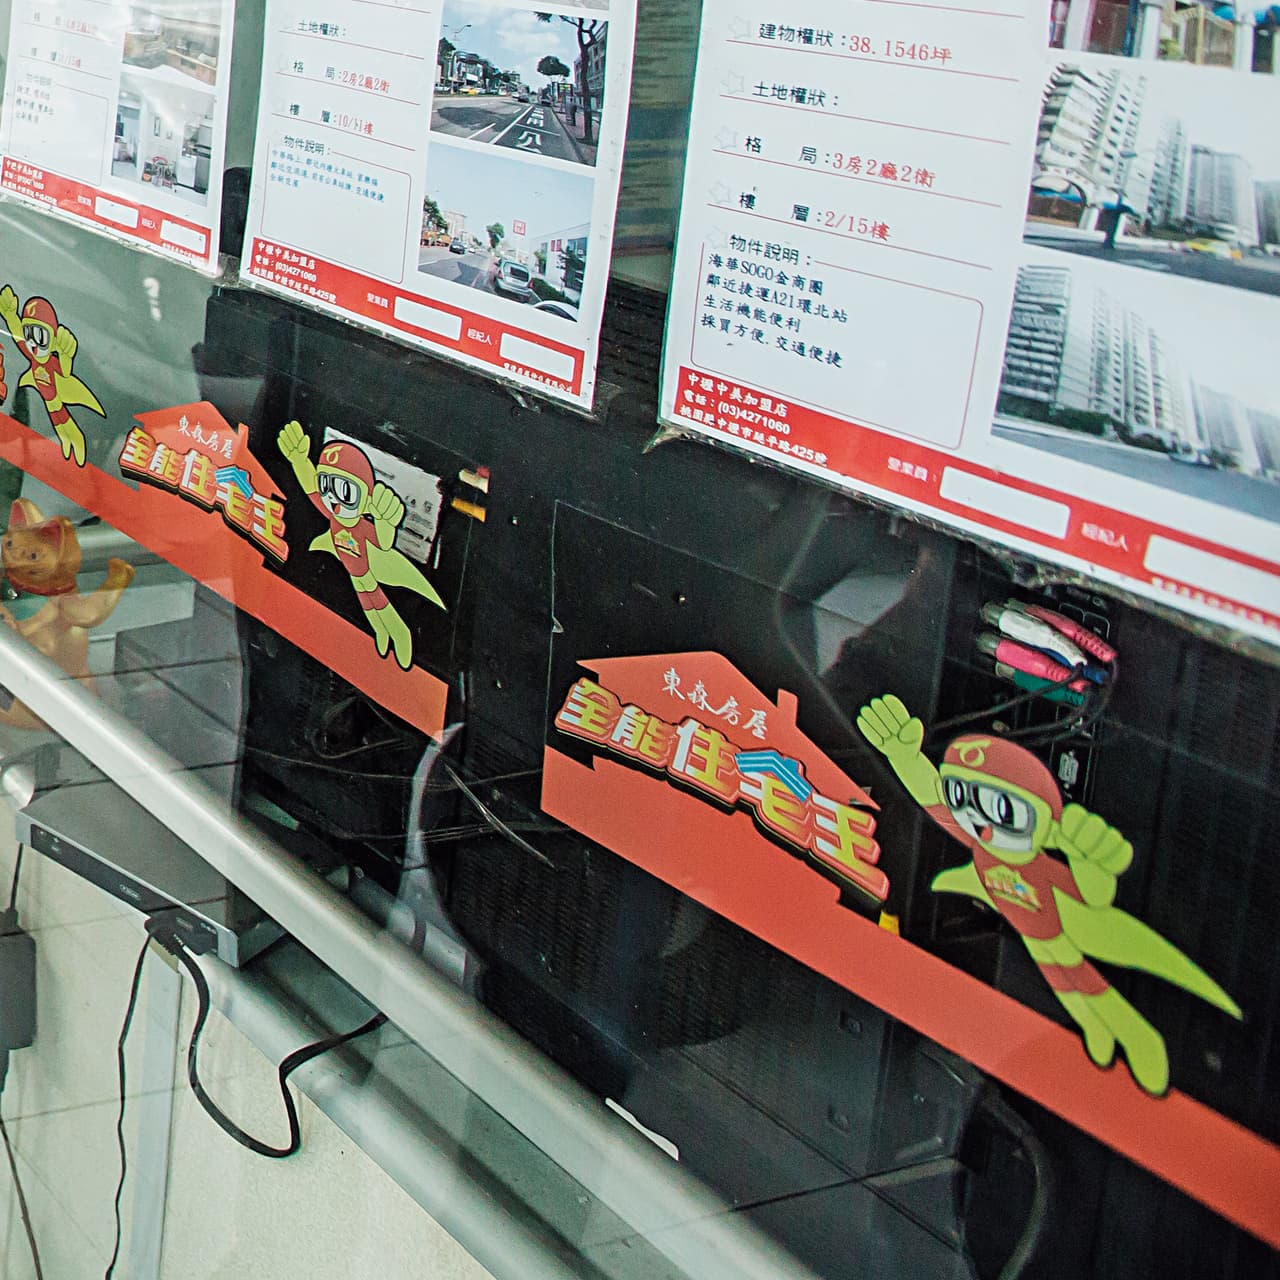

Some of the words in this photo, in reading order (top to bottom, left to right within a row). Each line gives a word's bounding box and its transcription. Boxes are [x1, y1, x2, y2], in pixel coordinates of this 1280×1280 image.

[744, 135, 762, 154] 格
[738, 192, 756, 210] 樓
[663, 668, 768, 740] 東森房屋
[555, 676, 888, 901] 全能住宅王
